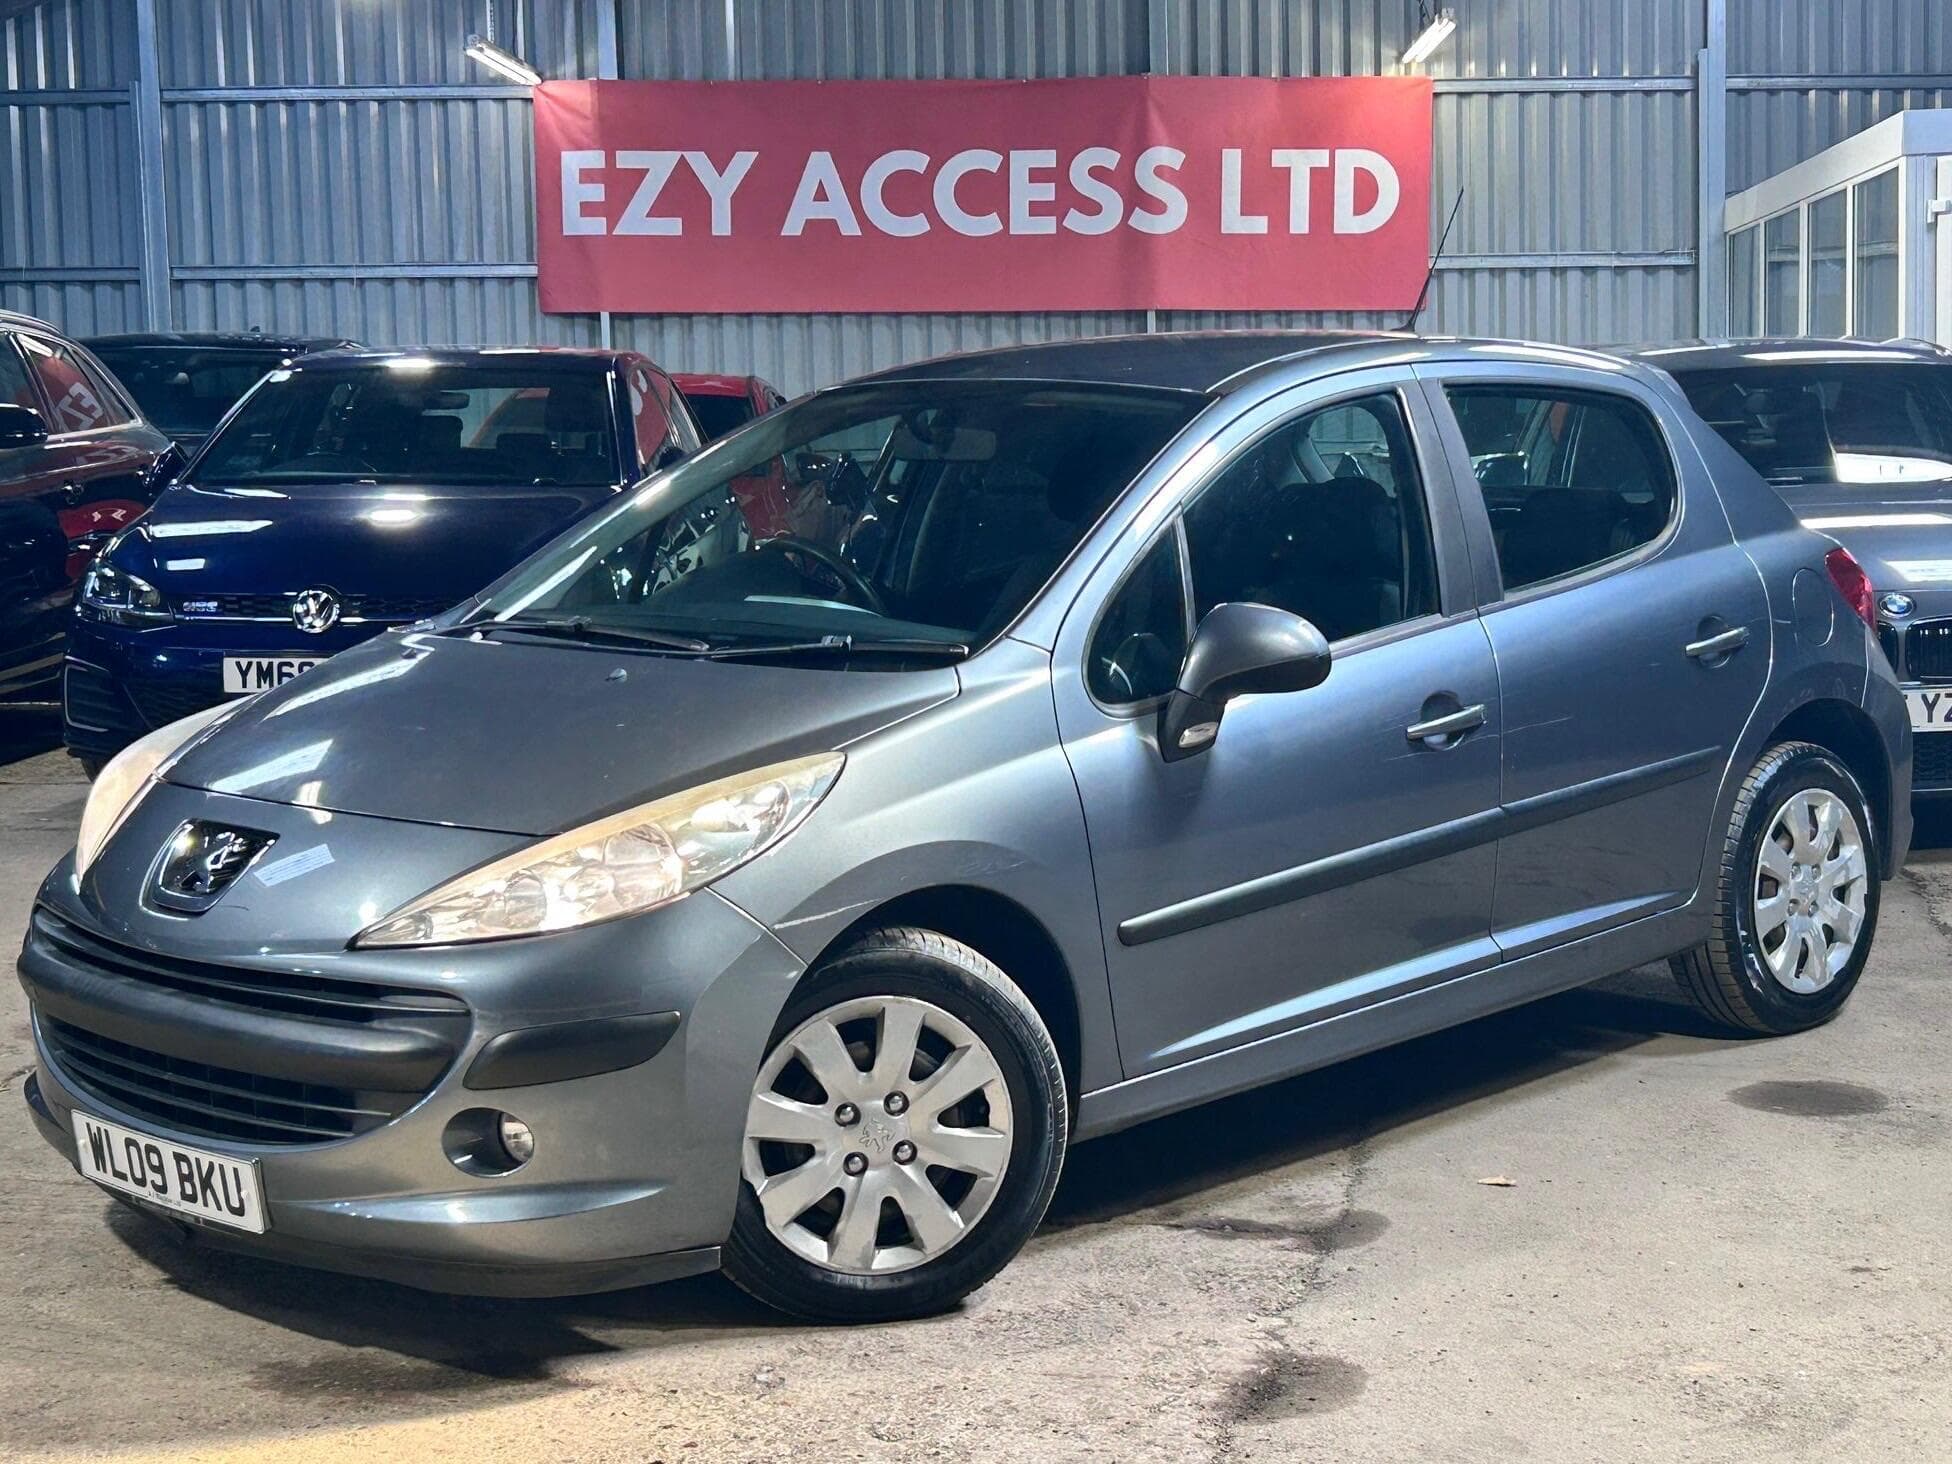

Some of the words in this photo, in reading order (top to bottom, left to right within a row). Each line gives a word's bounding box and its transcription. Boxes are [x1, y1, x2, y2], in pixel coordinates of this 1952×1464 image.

[561, 150, 758, 236] EZY
[782, 147, 1188, 237] ACCESS
[1221, 148, 1400, 235] LTD
[86, 1122, 168, 1194] WL09
[173, 1151, 245, 1217] BKU
